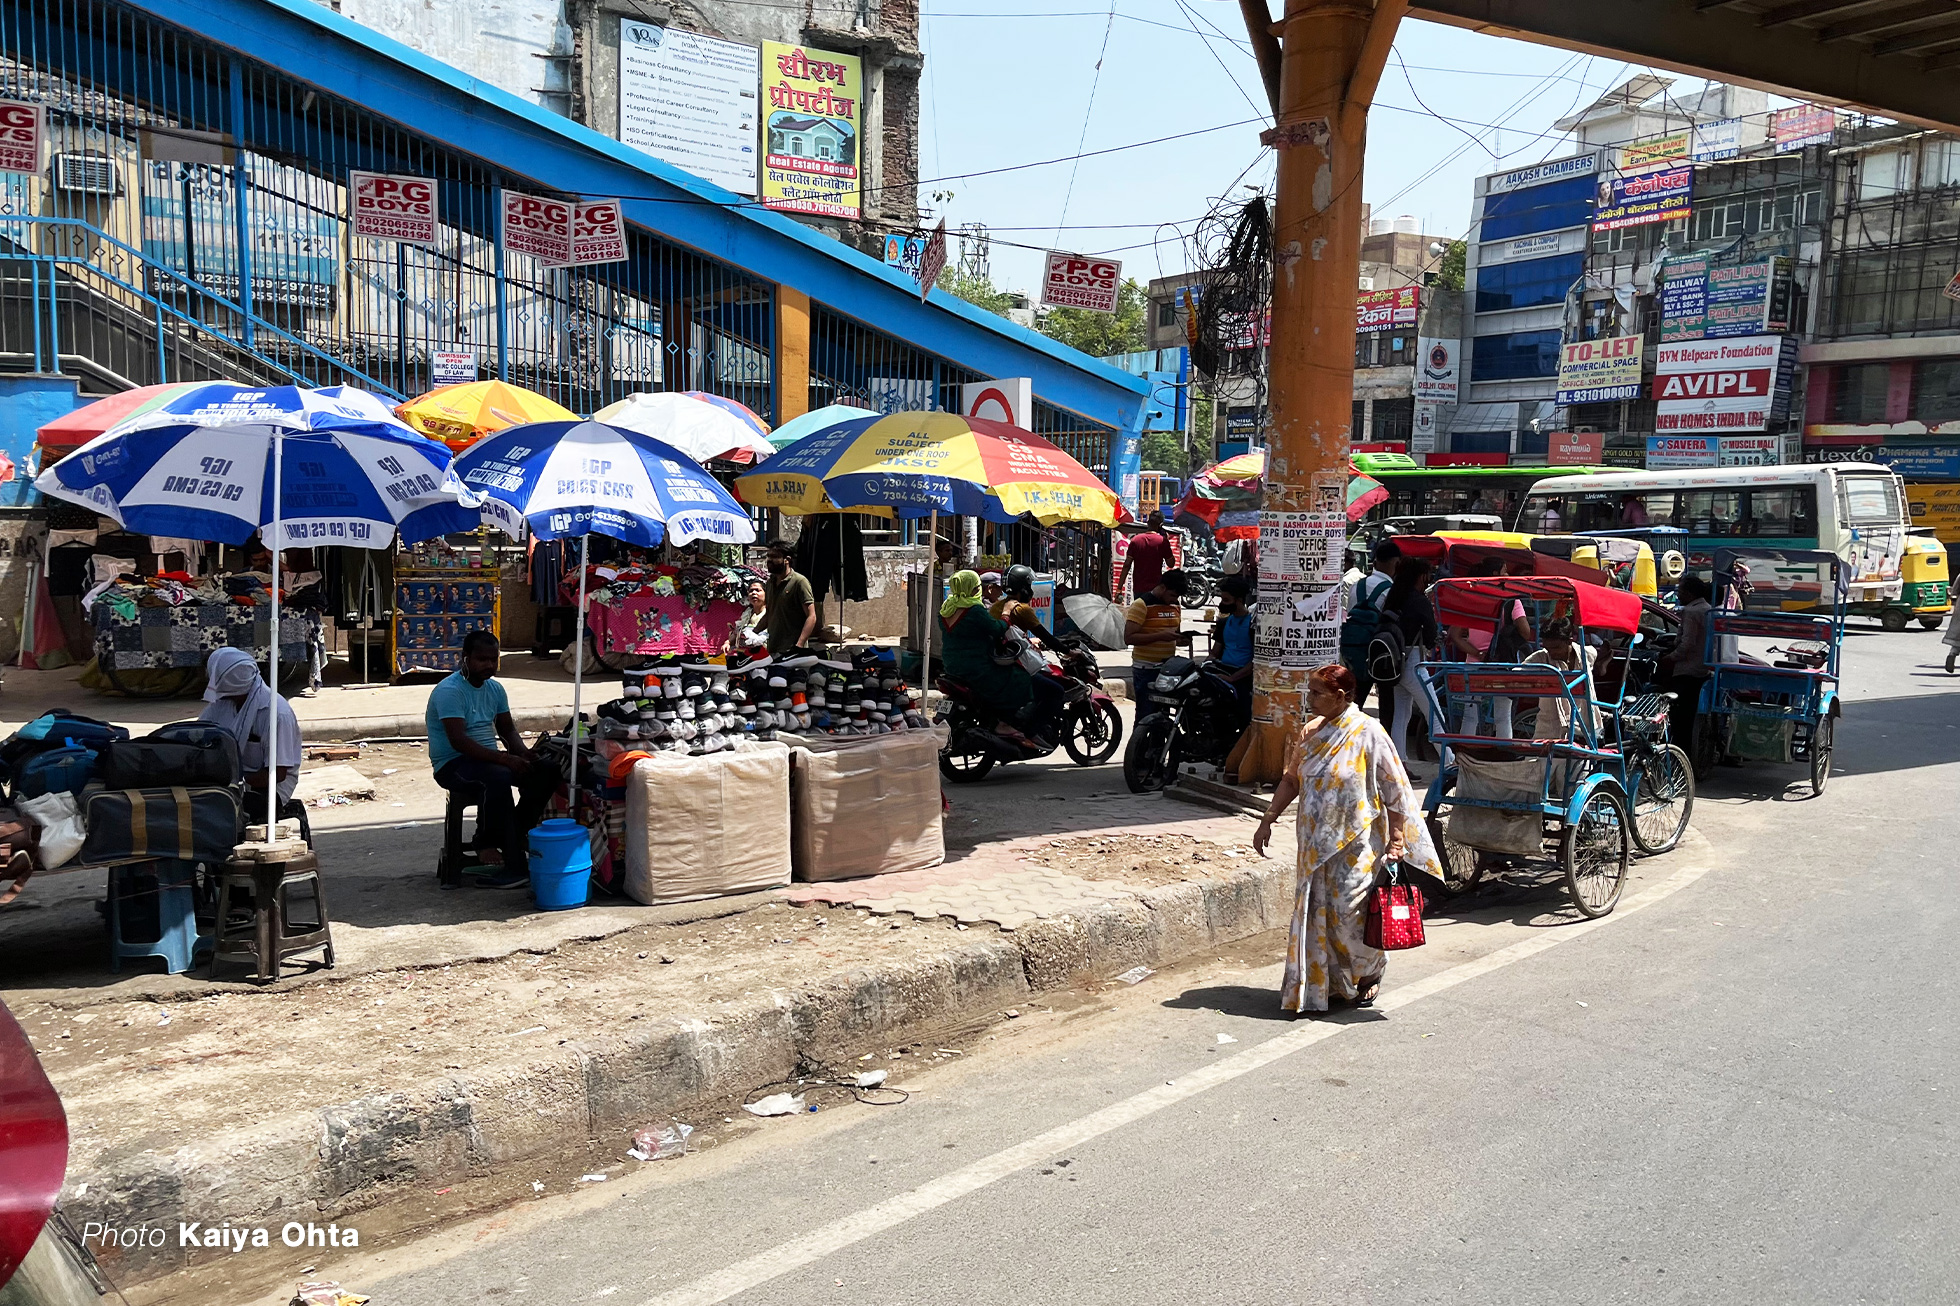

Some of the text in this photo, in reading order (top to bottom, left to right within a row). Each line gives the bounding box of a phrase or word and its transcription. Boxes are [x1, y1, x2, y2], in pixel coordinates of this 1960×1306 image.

[741, 46, 757, 54] System
[630, 56, 656, 67] Business
[657, 62, 692, 75] Consultancy
[777, 48, 846, 86] सौरभ
[630, 69, 648, 78] MSME
[630, 92, 665, 104] Professional
[666, 100, 685, 109] Career
[685, 102, 719, 115] Consultancy
[630, 104, 682, 119] Legal Consultancy
[641, 129, 678, 141] Certifications
[630, 138, 690, 154] School Accreditations
[1662, 139, 1686, 149] MARKET
[769, 156, 854, 176] Real Estate Agents
[1630, 155, 1646, 165] Earn
[1506, 168, 1540, 185] AAKASH
[1542, 156, 1593, 177] CHAMBERS
[357, 179, 431, 202] New PG
[1624, 173, 1690, 196] केनोपस
[358, 197, 431, 214] BOYS
[521, 199, 568, 224] PG
[1627, 203, 1658, 214] बोलना
[358, 216, 432, 231] 7902065253
[507, 213, 568, 236] BOYS
[358, 224, 431, 240] 9643340196
[506, 231, 568, 252] 7902065253
[506, 239, 568, 260] 9643340196
[1051, 259, 1116, 280] New PG
[1050, 273, 1113, 289] BOYS
[1663, 277, 1706, 291] RAILWAY
[1047, 288, 1112, 302] 7902065253
[1400, 288, 1413, 297] FREE
[1046, 295, 1110, 309] 9643340196
[1664, 307, 1704, 318] DELHI POLICE
[1662, 315, 1705, 328] C-TET
[1661, 330, 1705, 341] DSSSB
[1566, 337, 1639, 363] TO-LET
[1659, 344, 1773, 363] BVM Helpcare Foundation
[1562, 357, 1639, 374] COMMERCIAL SPACE
[1418, 381, 1457, 390] DELHI CRIME
[1561, 379, 1585, 388] OFFICE
[1588, 377, 1606, 386] SHOP
[1662, 372, 1757, 397] AVIPL
[232, 392, 267, 402] IGP
[1573, 385, 1639, 402] 9310108007
[333, 404, 367, 418] IGP
[1656, 414, 1680, 429] NEW
[1680, 412, 1715, 428] HOMES
[1716, 411, 1746, 427] INDIA
[827, 430, 852, 440] CA
[908, 431, 930, 439] ALL
[998, 435, 1027, 445] CA
[809, 439, 842, 448] FOUND
[888, 439, 944, 449] SUBJECT
[1007, 445, 1034, 454] CS
[1667, 439, 1775, 450] SAVERA MUSCLE MALL
[505, 446, 532, 460] IGP
[797, 447, 832, 457] INTER
[875, 448, 905, 456] UNDER
[927, 450, 950, 458] ROOF
[1010, 453, 1049, 464] CMA
[1820, 447, 1959, 462] texco DHAMAKA SALE
[490, 461, 508, 473] TIMES
[659, 459, 682, 475] IGP
[777, 457, 820, 469] FINAL
[880, 458, 939, 469] JKSC
[1038, 463, 1060, 471] BEST
[1011, 468, 1069, 479] FACULTIES
[766, 481, 782, 494] J.K.
[883, 478, 951, 492] 7304 454 716
[883, 491, 949, 506] 7304 454 717
[1050, 490, 1082, 508] SHAH
[550, 513, 573, 532] IGP
[1282, 521, 1323, 529] AASHIYANA
[1269, 528, 1280, 537] PG
[1282, 529, 1308, 538] BOYS
[1325, 529, 1342, 538] BOYS
[1298, 539, 1327, 551] OFFICE
[1298, 557, 1327, 572] RENT
[1286, 628, 1337, 639] CS. NITESH
[1285, 639, 1336, 649] KR. JAISWAL
